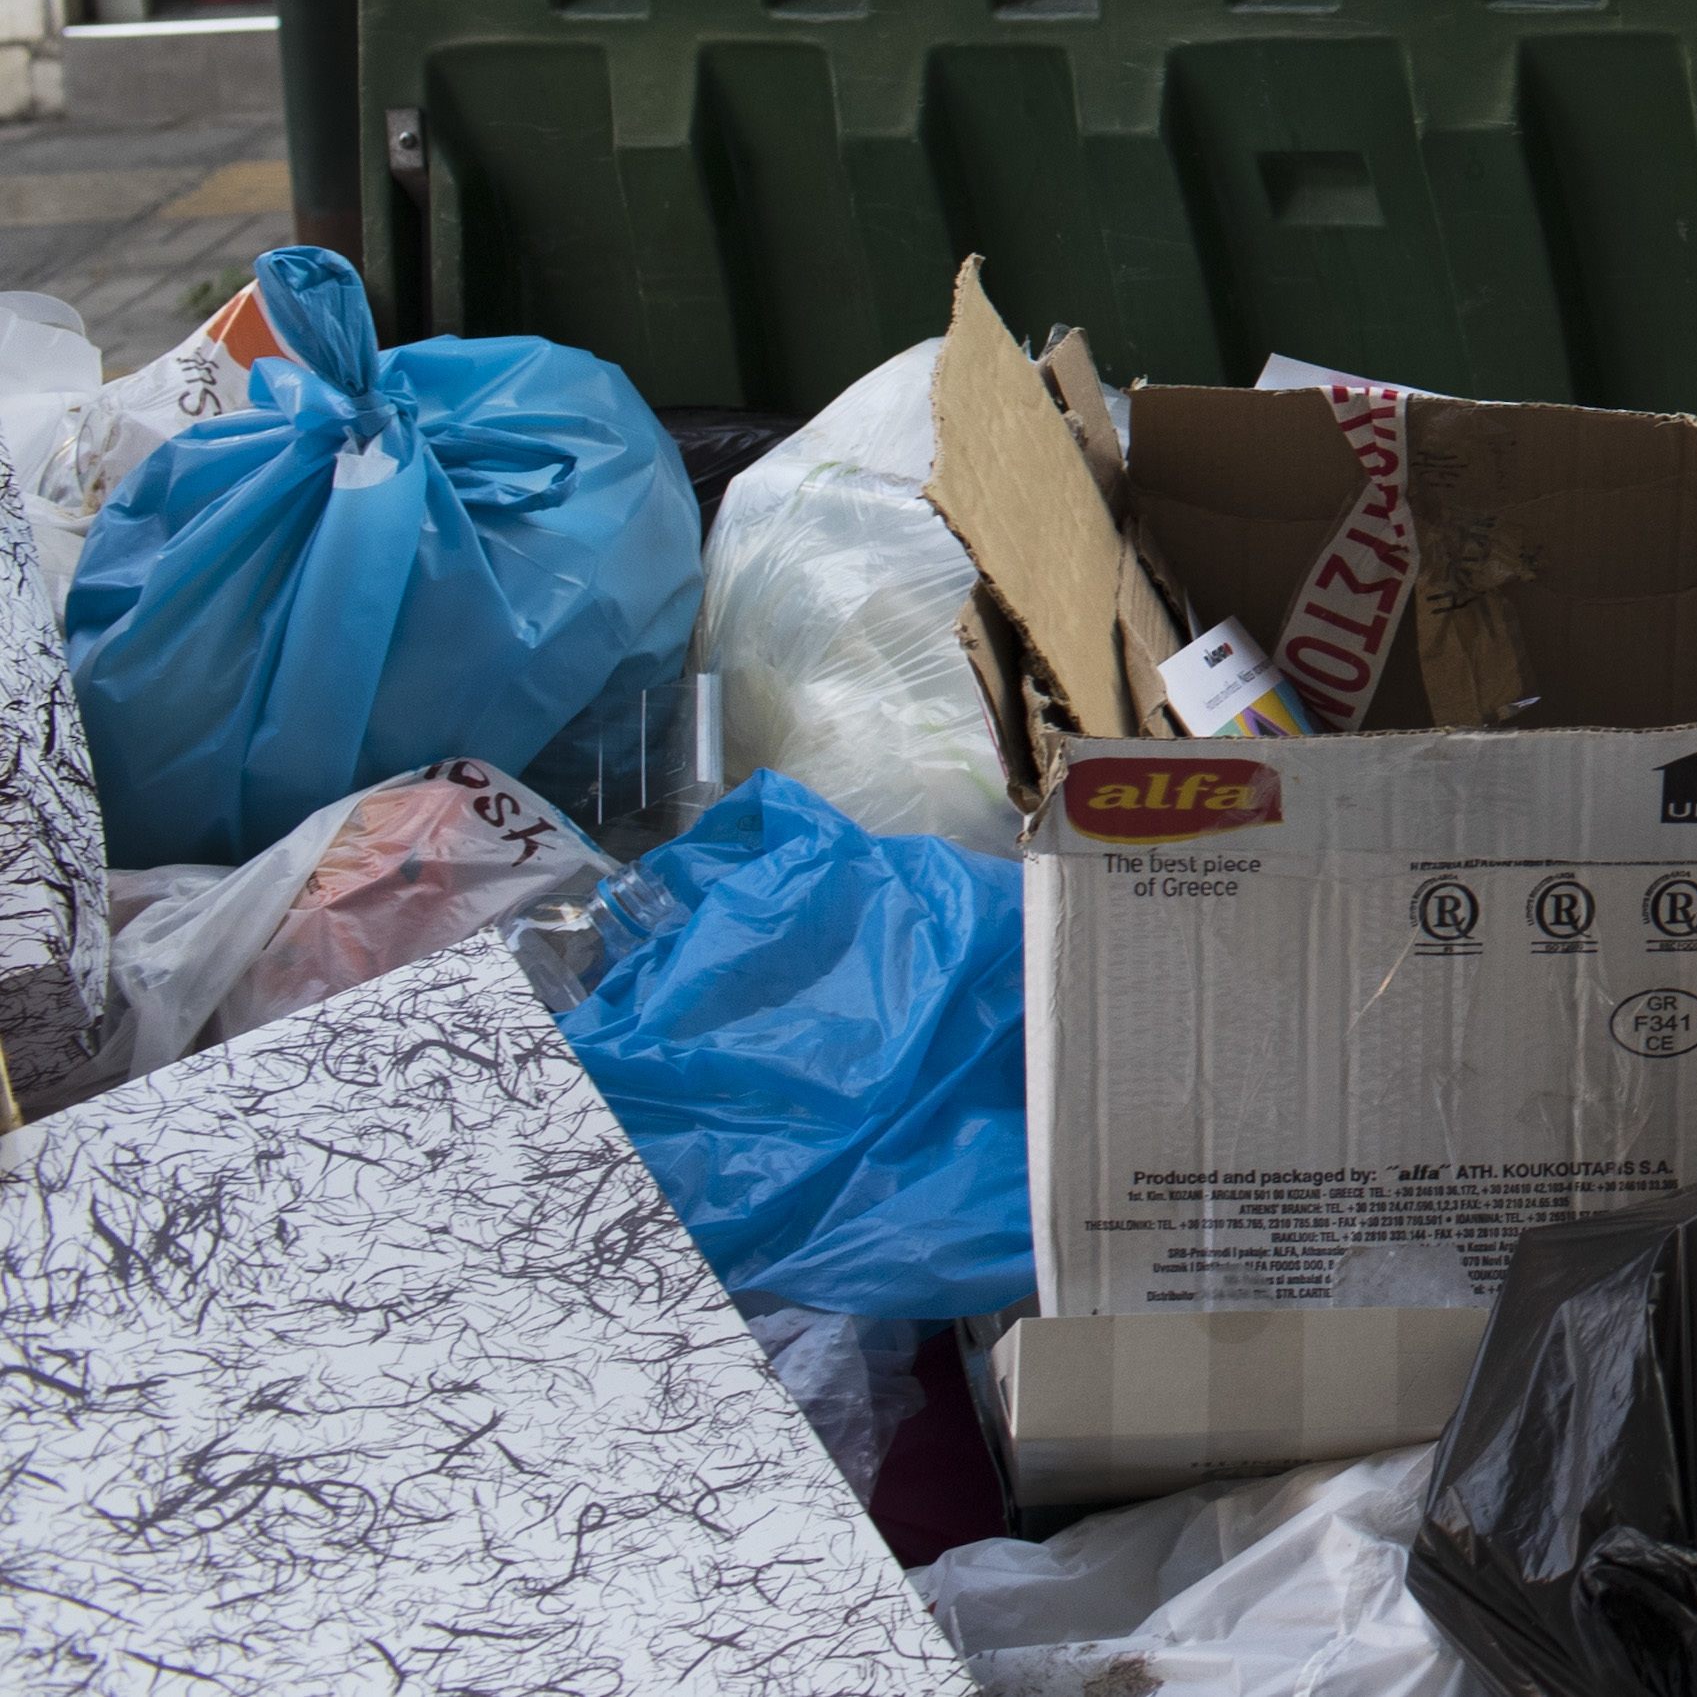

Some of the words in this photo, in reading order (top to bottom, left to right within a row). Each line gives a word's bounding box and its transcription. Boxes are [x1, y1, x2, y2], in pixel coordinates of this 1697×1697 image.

[1087, 773, 1257, 810] alfa
[1104, 854, 1143, 873] The
[1150, 855, 1197, 873] best
[1204, 856, 1261, 876] piece
[1134, 878, 1157, 896] of
[1163, 878, 1239, 897] Greece
[1647, 995, 1678, 1011] GR
[1634, 1014, 1692, 1032] F341
[1645, 1035, 1674, 1051] CE
[1134, 1170, 1218, 1185] Produced
[1223, 1169, 1255, 1184] and
[1261, 1168, 1346, 1186] packaged
[1350, 1168, 1377, 1184] by:
[1456, 1165, 1498, 1180] ATH.
[1639, 1160, 1674, 1175] S.A.
[1169, 1190, 1201, 1201] KOZANI
[1254, 1189, 1270, 1200] 501
[1287, 1188, 1321, 1200] KOZANI
[1329, 1187, 1365, 1199] GREECE
[1597, 1181, 1617, 1193] +30
[1619, 1180, 1647, 1192] 24610
[1281, 1203, 1323, 1215] BRANCH:
[1369, 1201, 1387, 1213] 210
[1268, 1217, 1290, 1229] 2310
[1338, 1216, 1357, 1227] FAX
[1434, 1228, 1453, 1240] FAX
[1477, 1227, 1500, 1239] 2810
[1299, 1287, 1332, 1298] CARTIE
